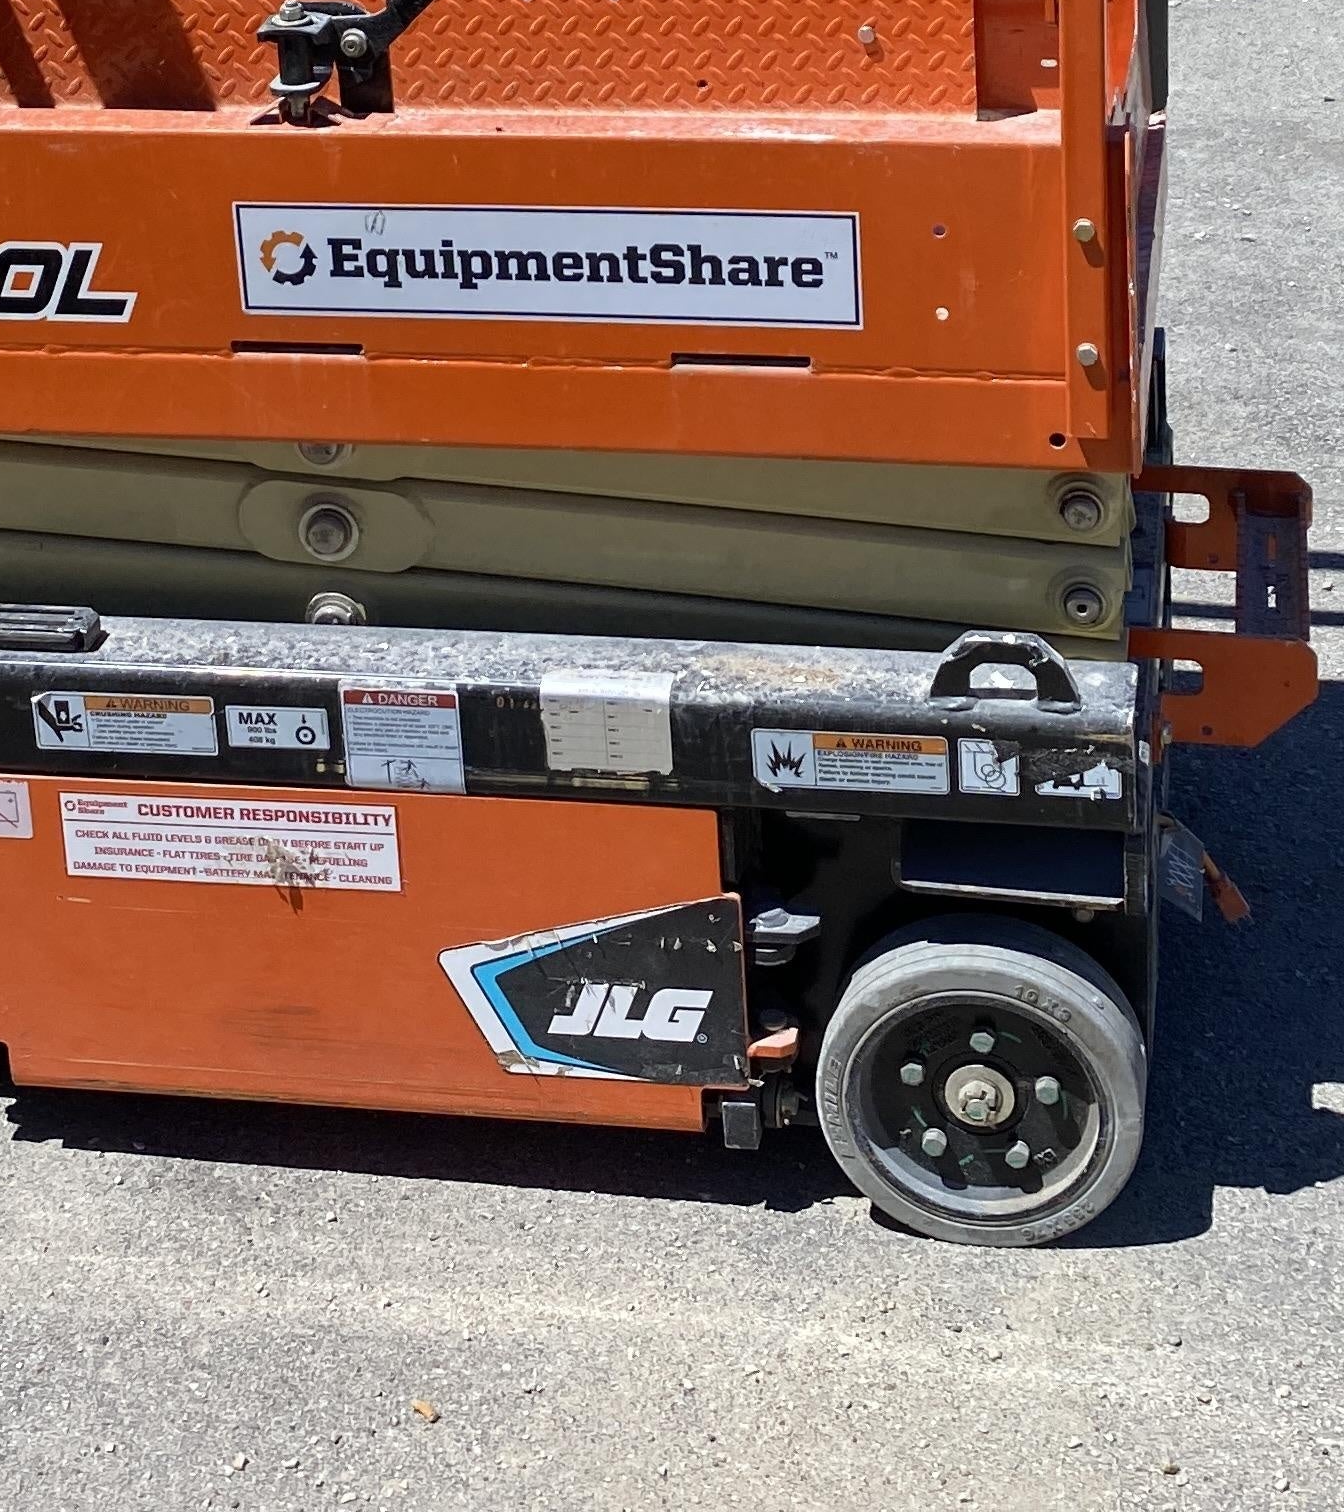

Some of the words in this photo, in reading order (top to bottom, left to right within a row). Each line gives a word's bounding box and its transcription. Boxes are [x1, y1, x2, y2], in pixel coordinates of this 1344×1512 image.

[327, 237, 824, 290] EquipmentShare
[120, 699, 190, 712] WARNING
[378, 693, 438, 707] DANGER
[238, 712, 278, 726] MAX
[851, 737, 922, 752] WARNING
[138, 803, 235, 820] CUSTOMER
[240, 808, 392, 827] RESPONSIBILITY
[75, 830, 109, 839] CHECK
[112, 831, 130, 840] ALL
[132, 832, 162, 842] FLUID
[165, 833, 202, 844] LEVELS
[215, 835, 255, 846] GREASE
[291, 839, 331, 849] BEFORE
[334, 841, 367, 850] START
[370, 843, 384, 851] UP
[94, 846, 155, 857] INSURANCE
[163, 849, 185, 859] FLAT
[189, 851, 221, 861] TIRES
[74, 861, 116, 872] DAMAGE
[119, 863, 133, 873] TO
[135, 864, 197, 875] EQUIPMENT
[205, 867, 251, 878] BATTERY
[339, 874, 392, 885] CLEANING
[547, 983, 714, 1043] JLG
